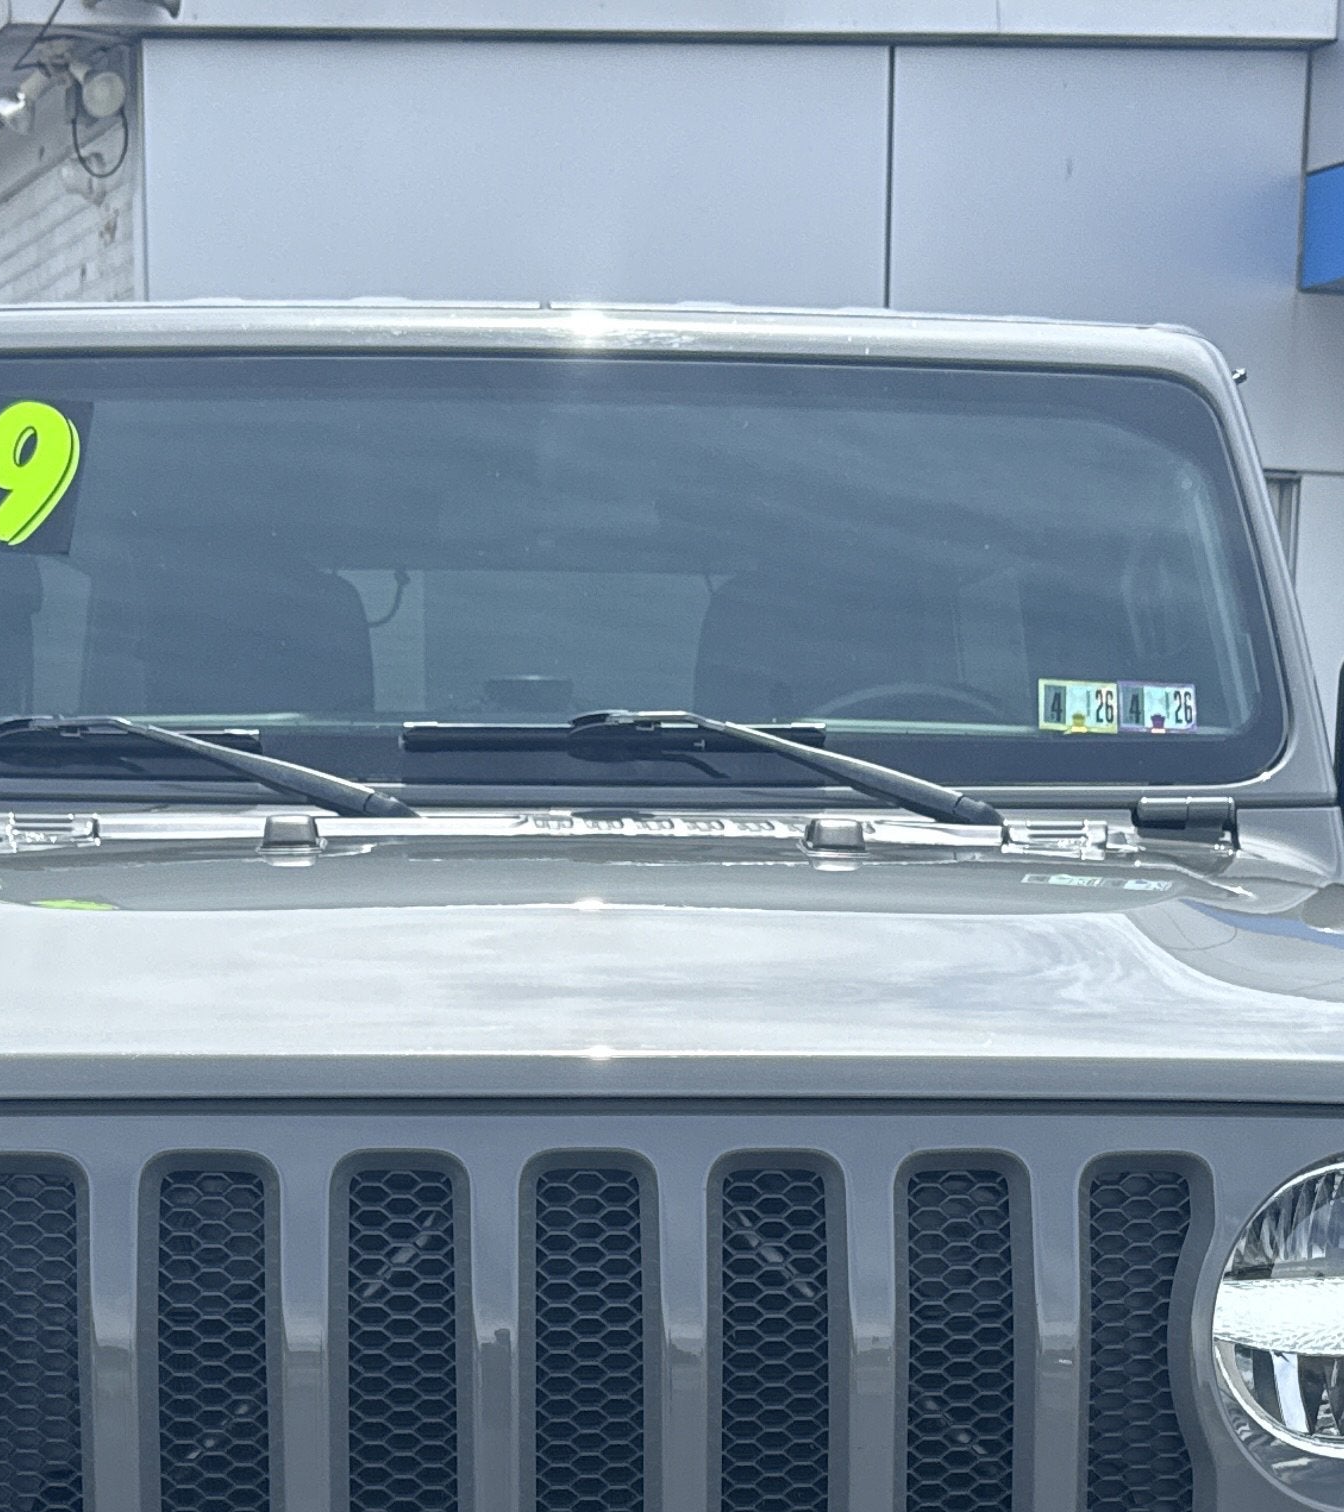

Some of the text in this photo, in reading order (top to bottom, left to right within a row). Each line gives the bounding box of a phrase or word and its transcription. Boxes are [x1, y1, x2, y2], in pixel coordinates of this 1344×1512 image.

[1051, 689, 1114, 724] 4 26
[1129, 691, 1193, 724] 4 26
